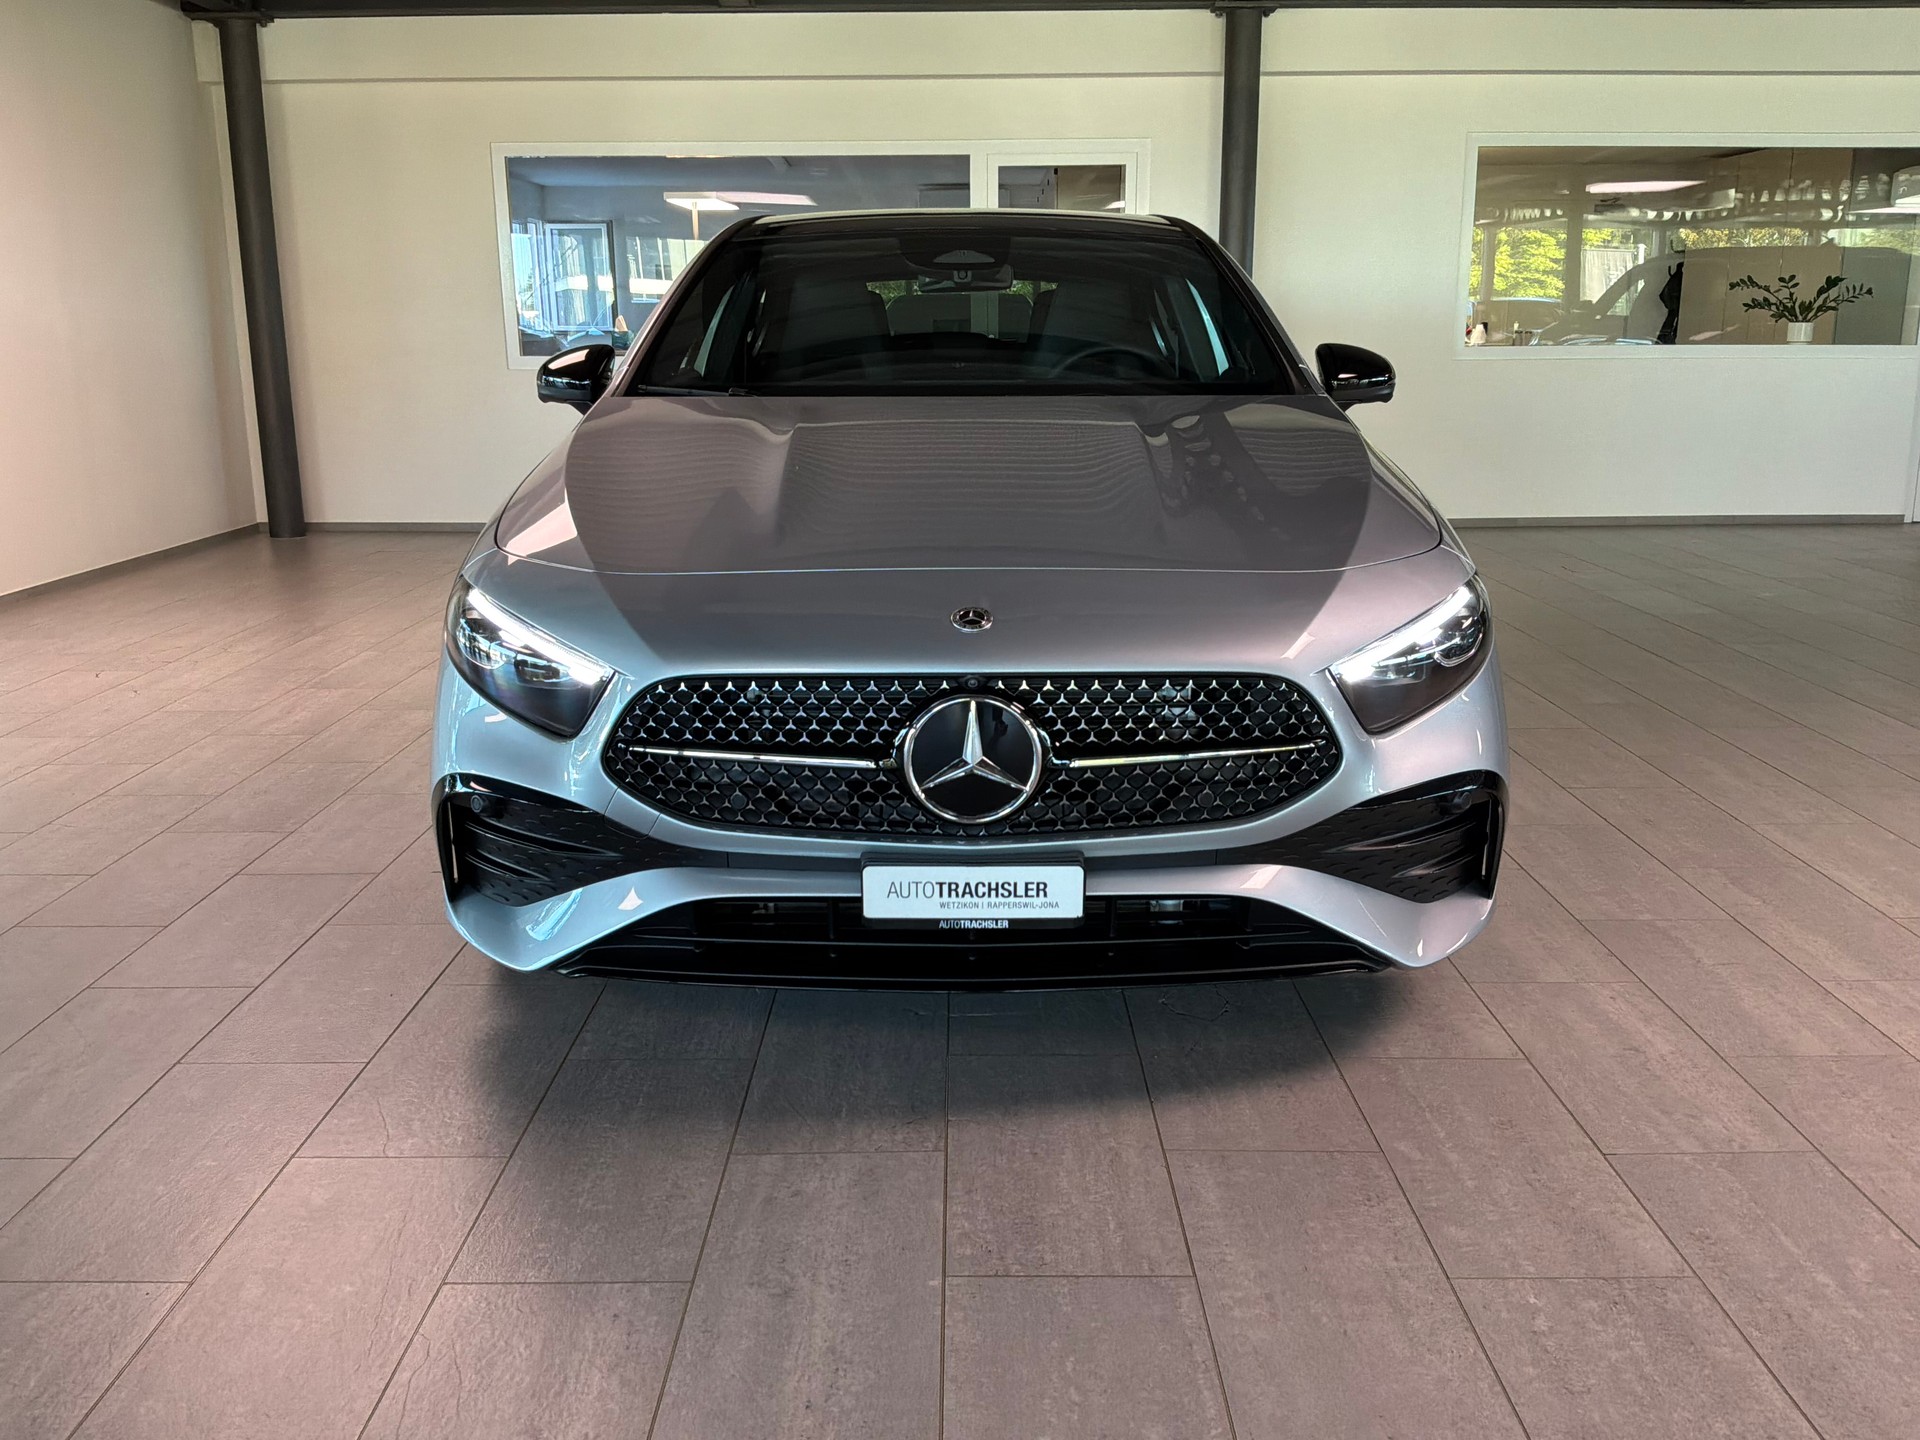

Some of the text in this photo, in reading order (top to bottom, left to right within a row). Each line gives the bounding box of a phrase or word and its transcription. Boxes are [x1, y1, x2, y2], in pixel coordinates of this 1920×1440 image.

[887, 881, 1048, 898] AUTOTRACHSLER
[939, 901, 980, 909] WETZIKON
[987, 901, 1060, 909] RAPPERSWIL-JONA
[939, 920, 1009, 929] AUTOTRACHSLER
